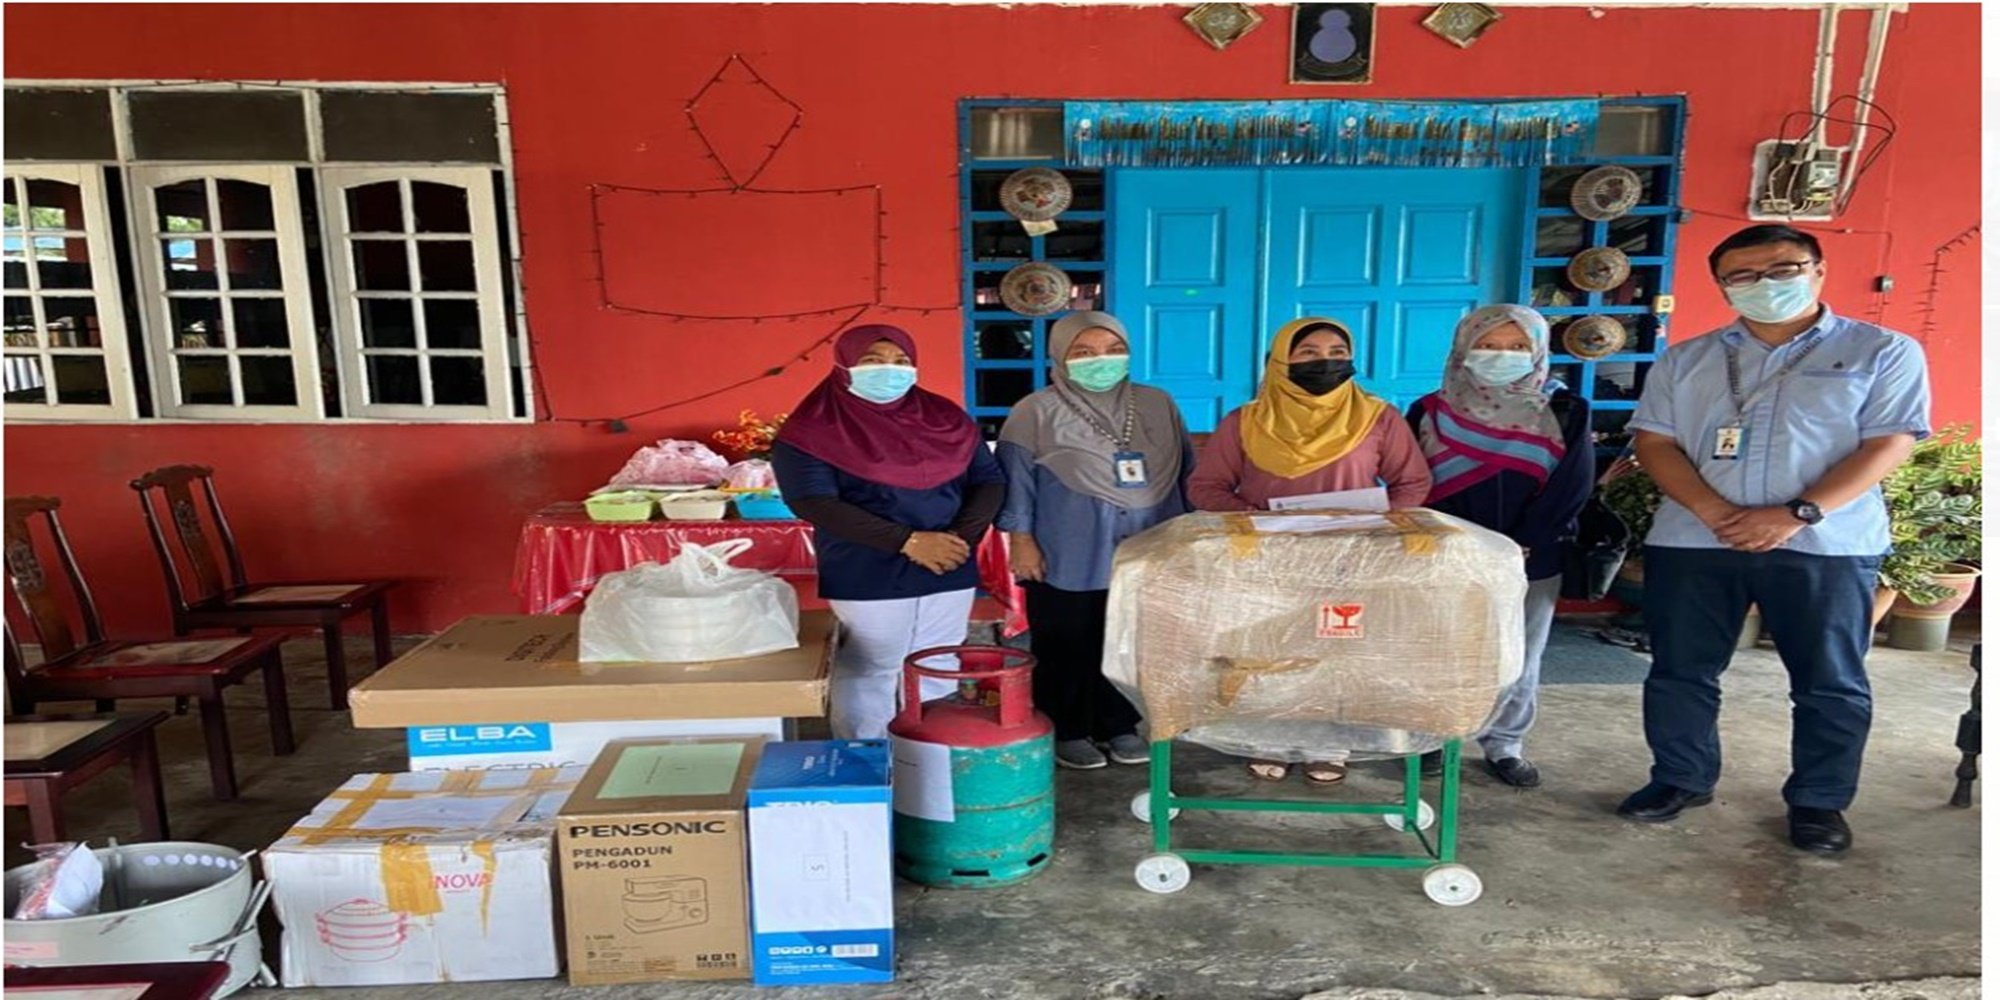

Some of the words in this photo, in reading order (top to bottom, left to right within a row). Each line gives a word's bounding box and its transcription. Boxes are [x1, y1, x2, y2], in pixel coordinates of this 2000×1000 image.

[420, 726, 536, 742] ELBA
[570, 821, 726, 838] PENSONIC
[573, 846, 673, 858] PENGADUN
[574, 859, 652, 870] PM-6001
